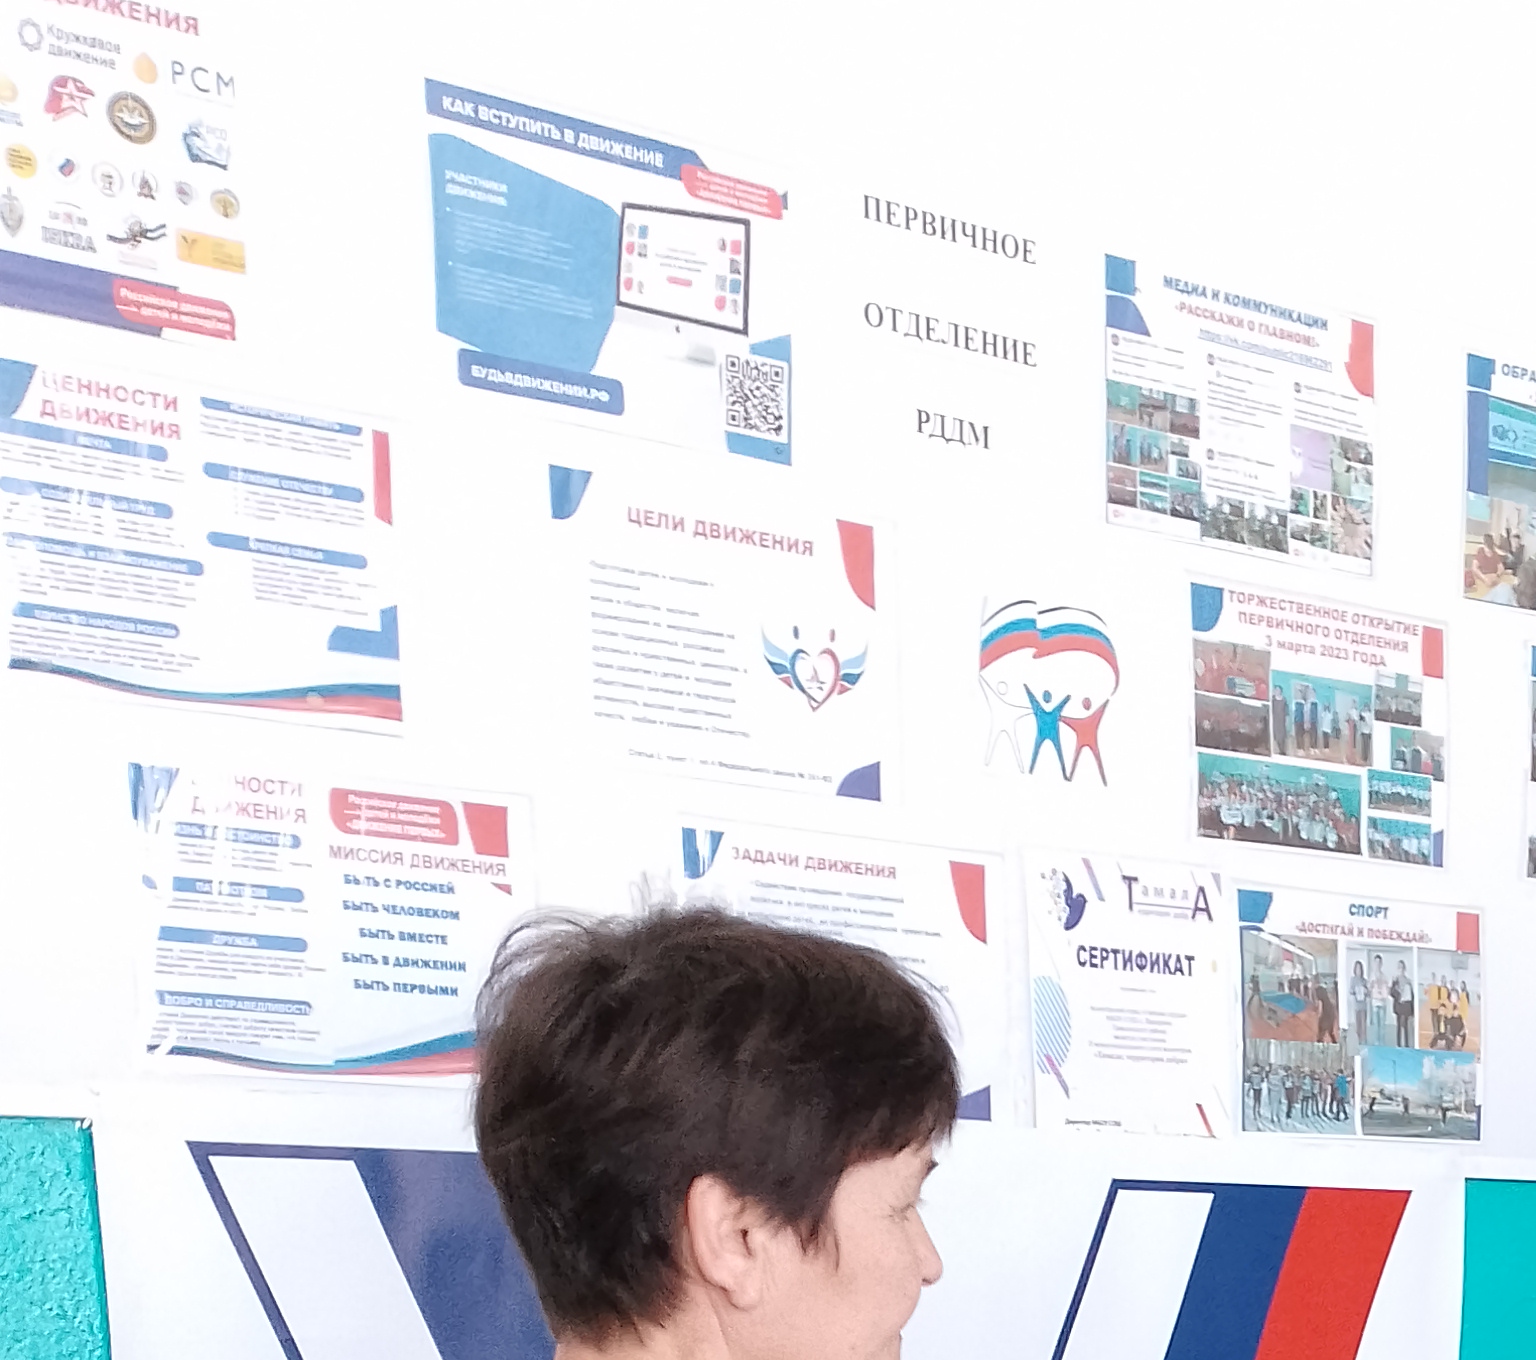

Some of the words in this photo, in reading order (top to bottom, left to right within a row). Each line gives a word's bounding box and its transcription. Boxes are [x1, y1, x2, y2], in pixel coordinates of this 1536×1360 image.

[44, 0, 200, 36] ИЖЕНИЯ
[442, 95, 475, 118] КАК
[478, 106, 562, 141] ВСТУПИТЬ
[564, 128, 576, 144] В
[577, 132, 665, 168] ДВИЖЕНИЕ
[862, 193, 1038, 265] ПЕРВИЧНОЕ
[1163, 274, 1208, 299] МЕДИА
[1211, 287, 1221, 302] И
[1223, 291, 1329, 331] КОММУНИКАЦИИ
[863, 301, 1038, 368] ОТДЕЛЕНИЕ
[1247, 319, 1256, 332] О
[39, 398, 182, 440] ДВИЖЕНИЯ
[915, 408, 991, 451] РДДМ
[627, 506, 685, 533] ЦЕЛИ
[693, 519, 814, 556] ДВИЖЕНИЯ
[1228, 589, 1348, 623] ТОРЖЕСТВЕННОЕ
[1351, 612, 1420, 636] ОТКРЫТИЕ
[1238, 611, 1330, 638] ПЕРВИЧНОГО
[1335, 629, 1409, 653] ОТДЕЛЕНИЯ
[1264, 635, 1273, 647] 3
[1320, 644, 1350, 661] 2023
[1352, 649, 1387, 668] ГОДА
[329, 844, 404, 867] МИССИЯ
[410, 853, 507, 877] ДВИЖЕНИЯ
[731, 846, 800, 868] ЗАДАЧИ
[804, 855, 897, 880] ДВИЖЕНИЯ
[343, 874, 380, 888] БЫТЬ
[383, 878, 392, 888] С
[395, 878, 456, 895] РОССИЕЙ
[342, 900, 379, 914] БЫТЬ
[381, 903, 460, 921] ЧЕЛОВЕКОМ
[1348, 903, 1389, 920] СПОРТ
[358, 927, 395, 941] БЫТЬ
[398, 930, 449, 946] ВМЕСТЕ
[341, 951, 379, 966] БЫТЬ
[381, 955, 390, 966] В
[392, 955, 467, 974] ДВИЖЕНИИ
[1076, 944, 1196, 977] СЕРТИФИКАТ
[353, 978, 390, 993] БЫТЬ
[393, 982, 459, 998] ПЕРВЫМИ
